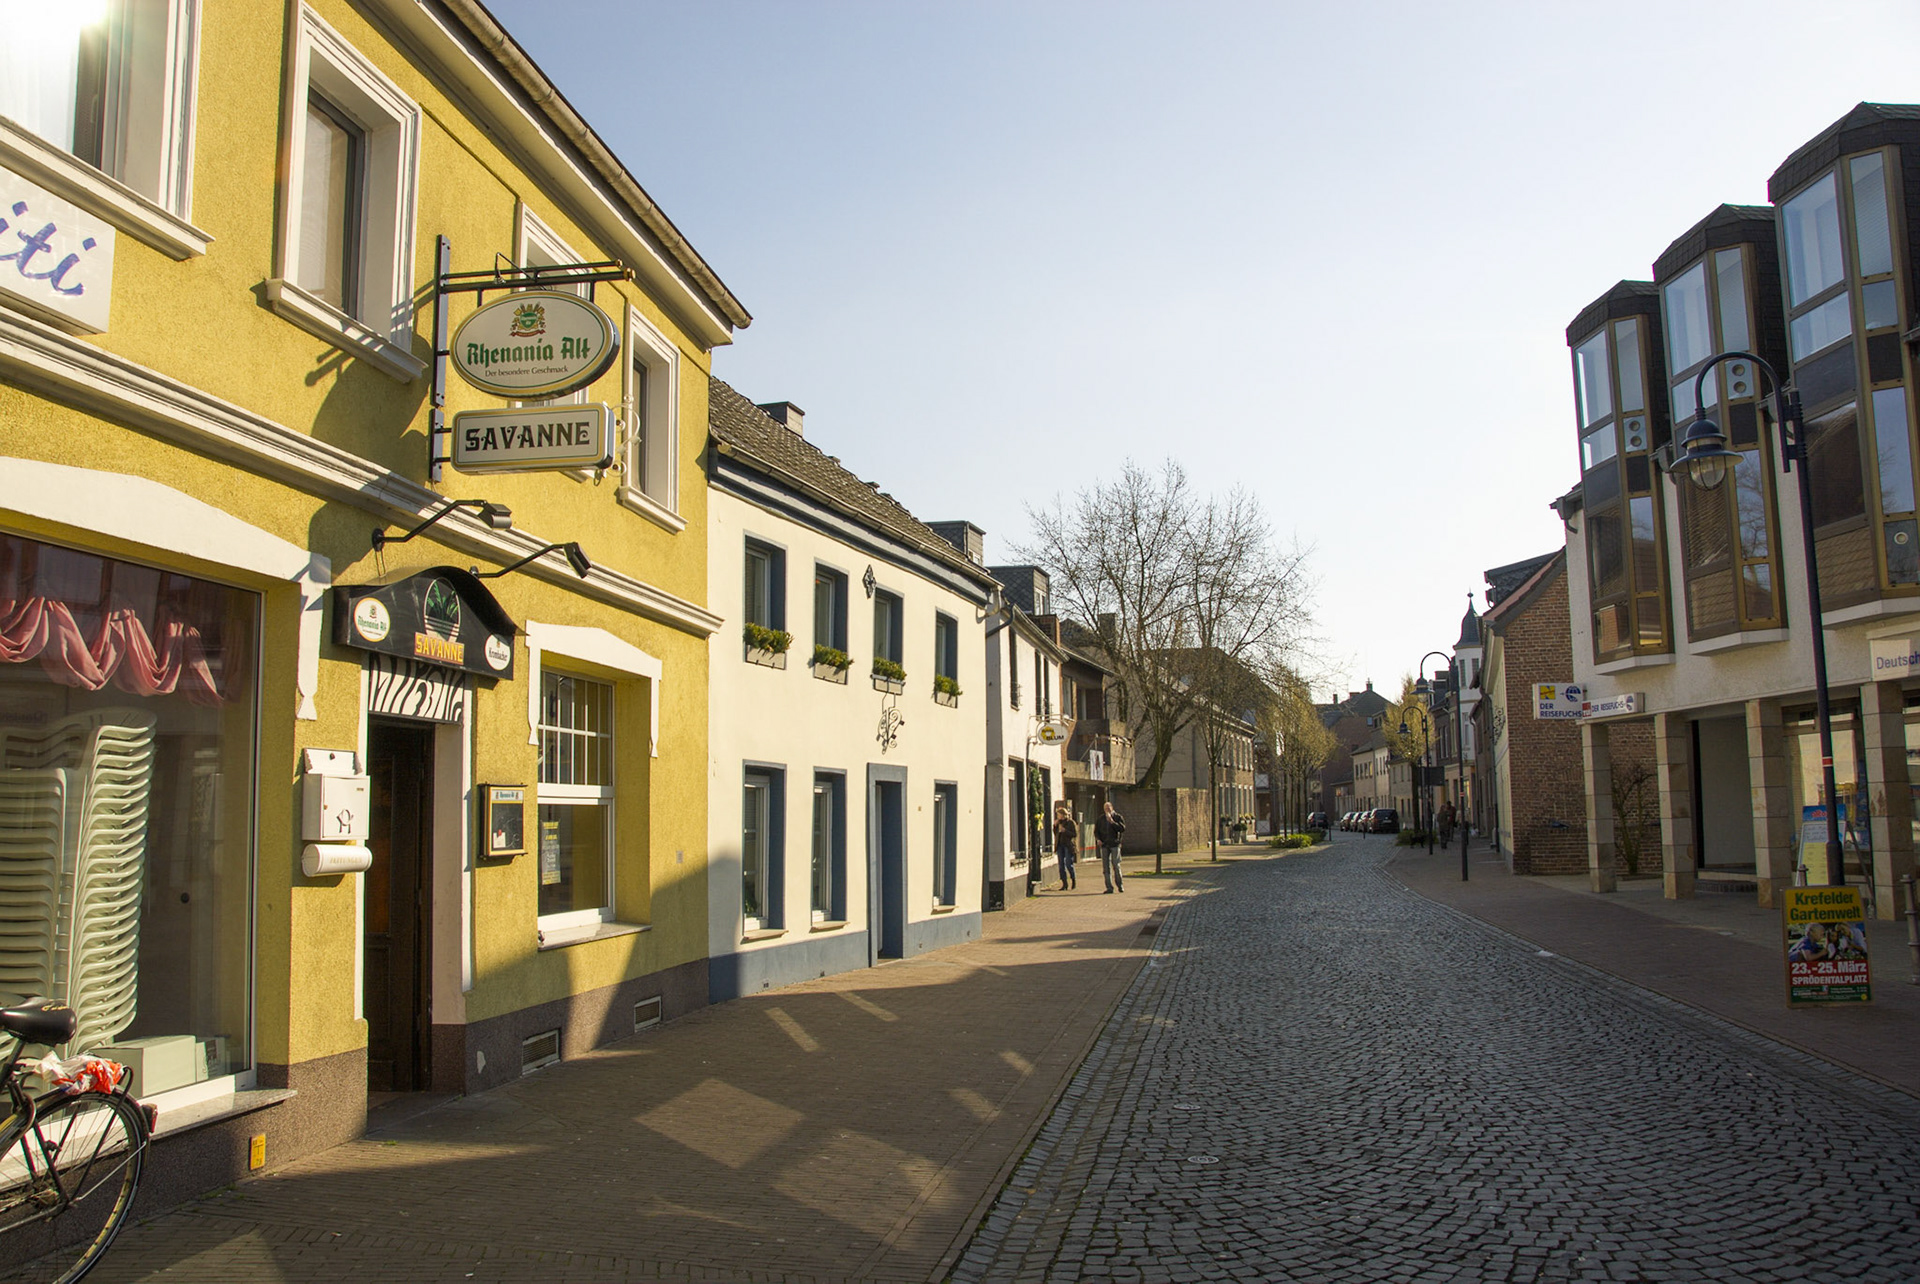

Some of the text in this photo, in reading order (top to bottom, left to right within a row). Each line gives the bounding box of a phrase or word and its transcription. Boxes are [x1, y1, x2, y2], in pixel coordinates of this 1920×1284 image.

[467, 336, 591, 368] Rhenania Alt
[485, 365, 569, 378] Der besondere Geschmack
[465, 422, 590, 452] SAVANNE
[415, 635, 464, 662] SAVANNE
[1540, 710, 1582, 718] REISEFUCHS
[1795, 891, 1854, 905] Krefelder
[1790, 906, 1861, 921] Gartenwelt
[1838, 961, 1867, 973] März
[1792, 975, 1867, 985] SPRÖDENTALPLATZ
